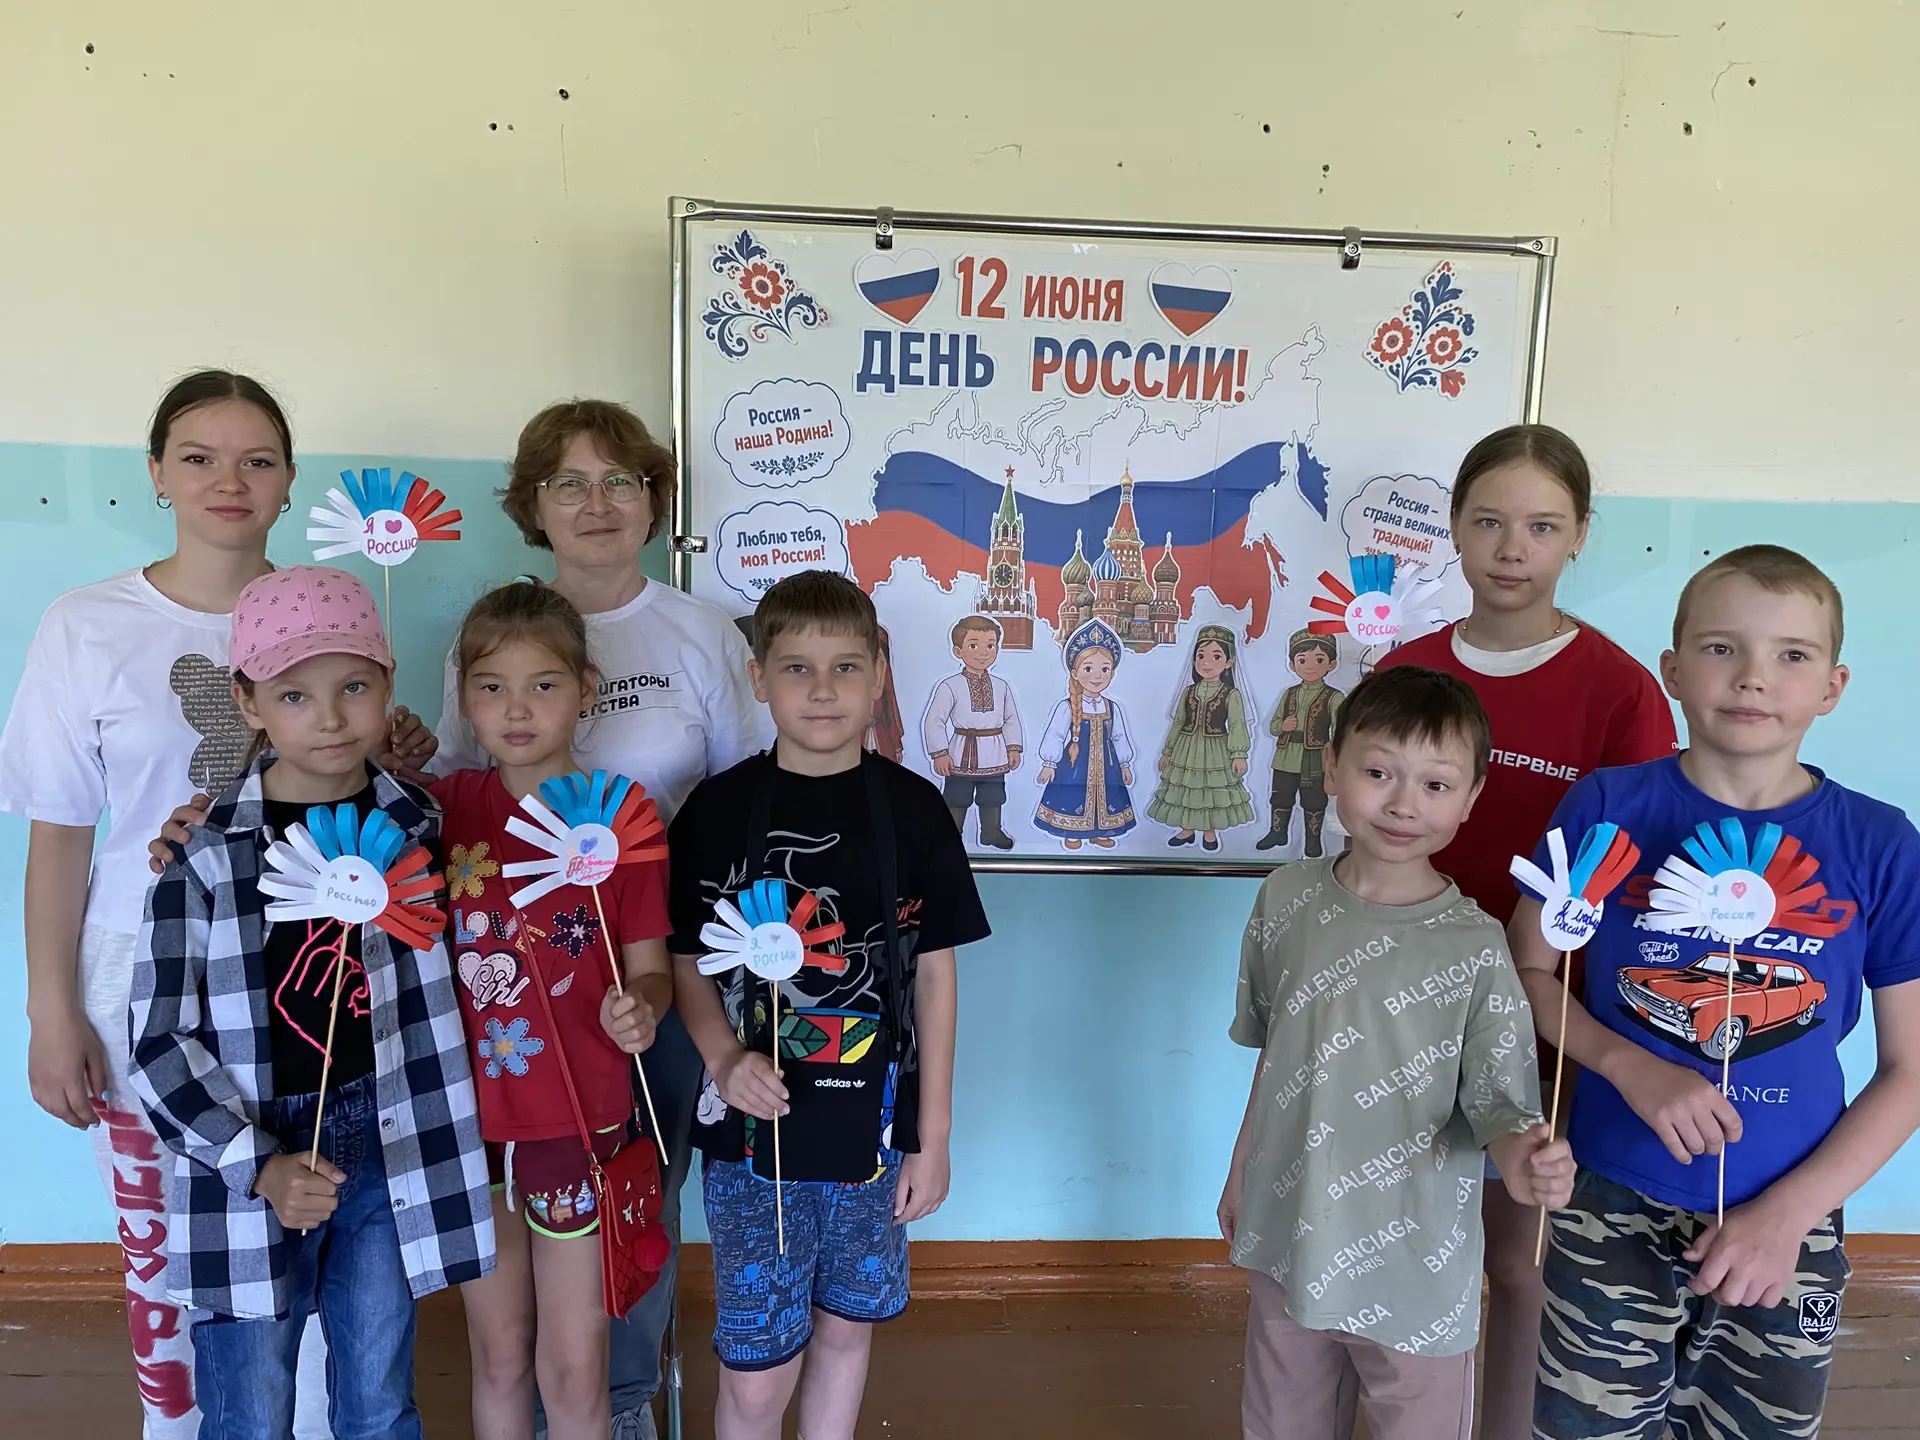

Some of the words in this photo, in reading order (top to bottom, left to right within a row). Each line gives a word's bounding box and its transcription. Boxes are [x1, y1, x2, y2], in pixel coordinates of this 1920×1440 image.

[956, 256, 1007, 318] 12
[1024, 277, 1123, 321] ИЮНЯ
[856, 331, 995, 392] ДЕНЬ
[1032, 336, 1248, 401] РОССИИ!
[748, 407, 800, 426] Россия
[734, 433, 773, 451] наша
[775, 420, 834, 444] Родина!
[1387, 491, 1430, 515] Россия
[363, 517, 375, 534] Я
[736, 530, 788, 548] Люблю
[790, 526, 826, 543] тебя,
[1363, 506, 1403, 527] страна
[1404, 518, 1451, 540] великих
[1372, 528, 1433, 553] традиций!
[740, 555, 769, 567] моя
[772, 545, 826, 565] Россия!
[1488, 748, 1580, 782] ПЕРВЫЕ
[1707, 884, 1719, 897] Я
[454, 909, 546, 953] LOVE
[1753, 933, 1824, 957] CAR
[471, 965, 531, 1012] Girl
[1285, 935, 1400, 1016] BALENCIAGA
[1323, 974, 1359, 1003] PARIS
[1383, 948, 1508, 1017] BALENCIAGA
[1433, 984, 1473, 1009] PARIS
[1275, 1025, 1365, 1110] BALENCIAGA
[1353, 1034, 1464, 1110] BALENCIAGA
[815, 1078, 851, 1088] adidas
[1404, 1072, 1434, 1101] PARIS
[1326, 1123, 1439, 1201] BALENCIAGA
[1375, 1164, 1412, 1191] PARIS
[1305, 1215, 1420, 1300] BALENCIAGA
[1346, 1254, 1386, 1280] PARIS
[1817, 1301, 1826, 1311] B
[1802, 1316, 1835, 1327] BALU
